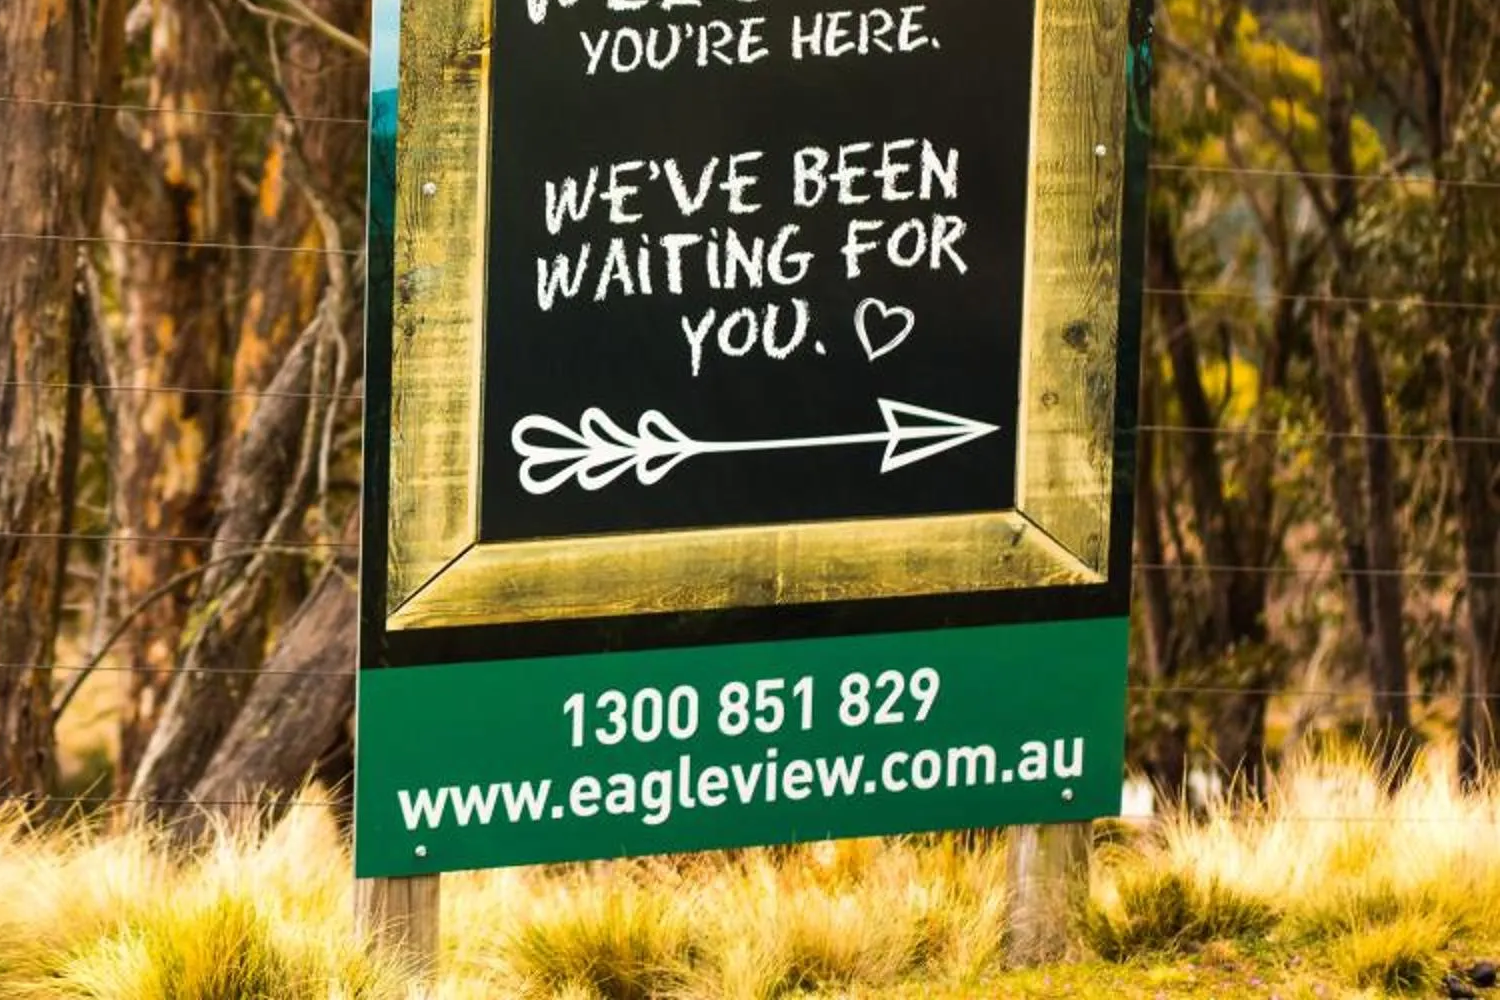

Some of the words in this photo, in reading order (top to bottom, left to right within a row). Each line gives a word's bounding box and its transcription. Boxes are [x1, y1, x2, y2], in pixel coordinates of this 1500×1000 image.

[580, 16, 769, 75] YOU'RE
[792, 5, 940, 60] HERE.
[546, 150, 764, 234] WE'VE
[794, 138, 959, 208] BEEN
[841, 213, 968, 279] FOR
[681, 298, 826, 376] YOU.
[563, 685, 699, 747] 1300
[717, 676, 813, 736] 851
[838, 667, 940, 727] 829
[398, 736, 1084, 825] www.eagleview.com.au
